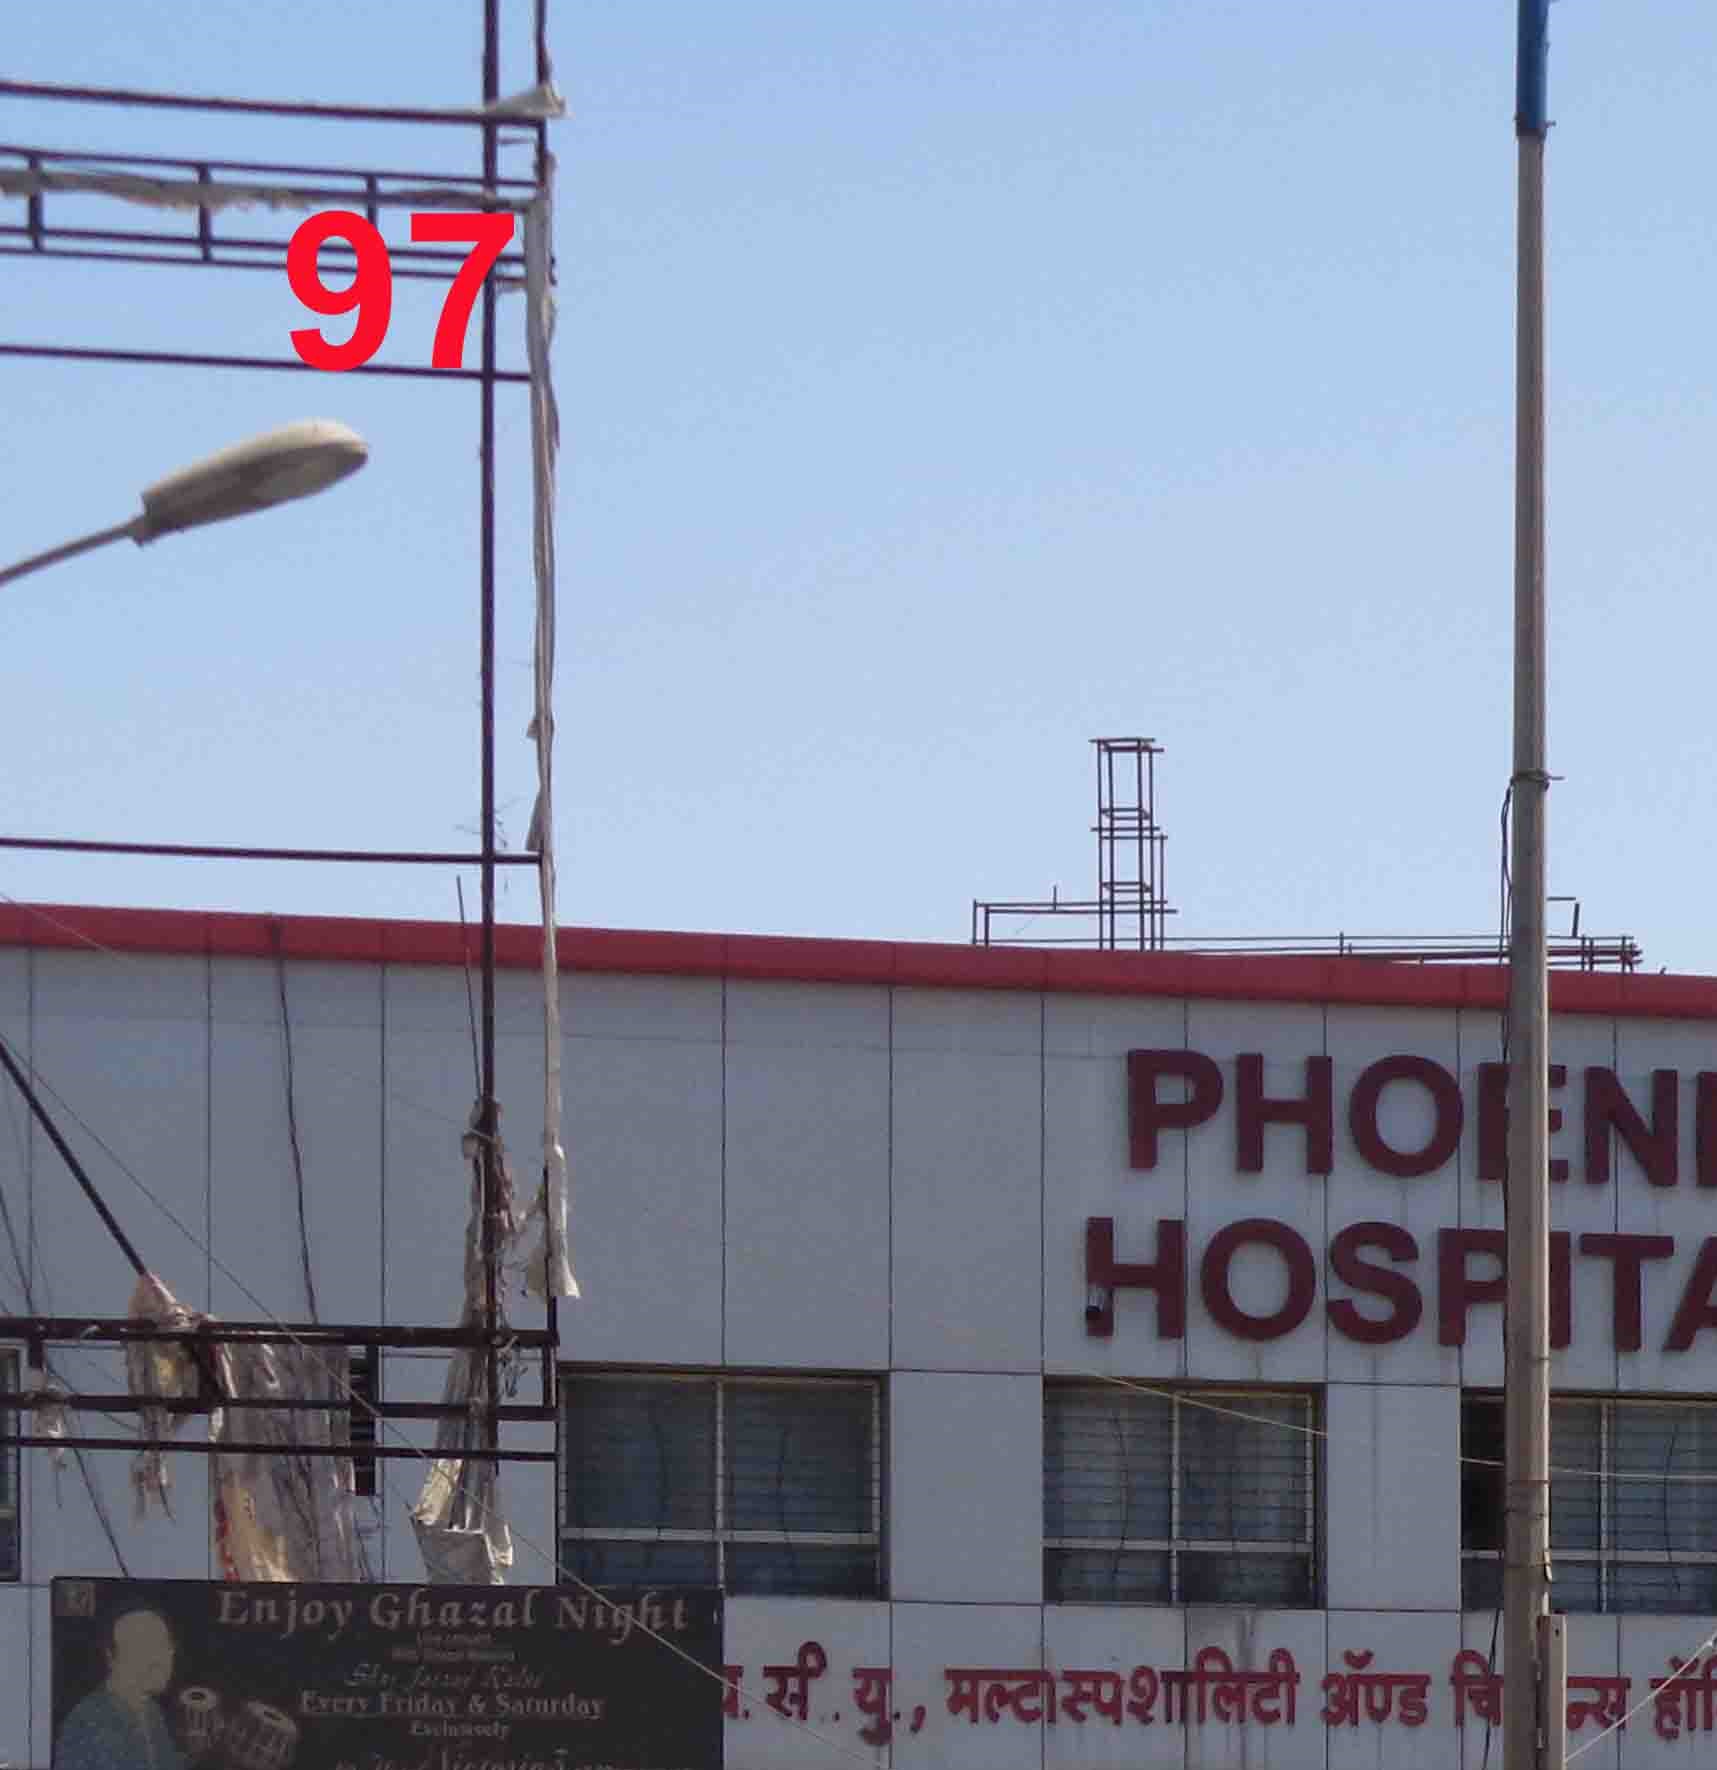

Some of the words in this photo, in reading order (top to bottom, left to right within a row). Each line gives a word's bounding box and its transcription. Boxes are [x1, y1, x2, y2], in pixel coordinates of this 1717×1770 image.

[216, 1588, 353, 1641] Enjoy
[368, 1588, 536, 1630] Ghazal
[553, 1589, 689, 1644] Night
[301, 1689, 370, 1718] Every
[378, 1691, 459, 1718] Friday
[468, 1693, 487, 1713] &
[494, 1691, 605, 1720] Saturday
